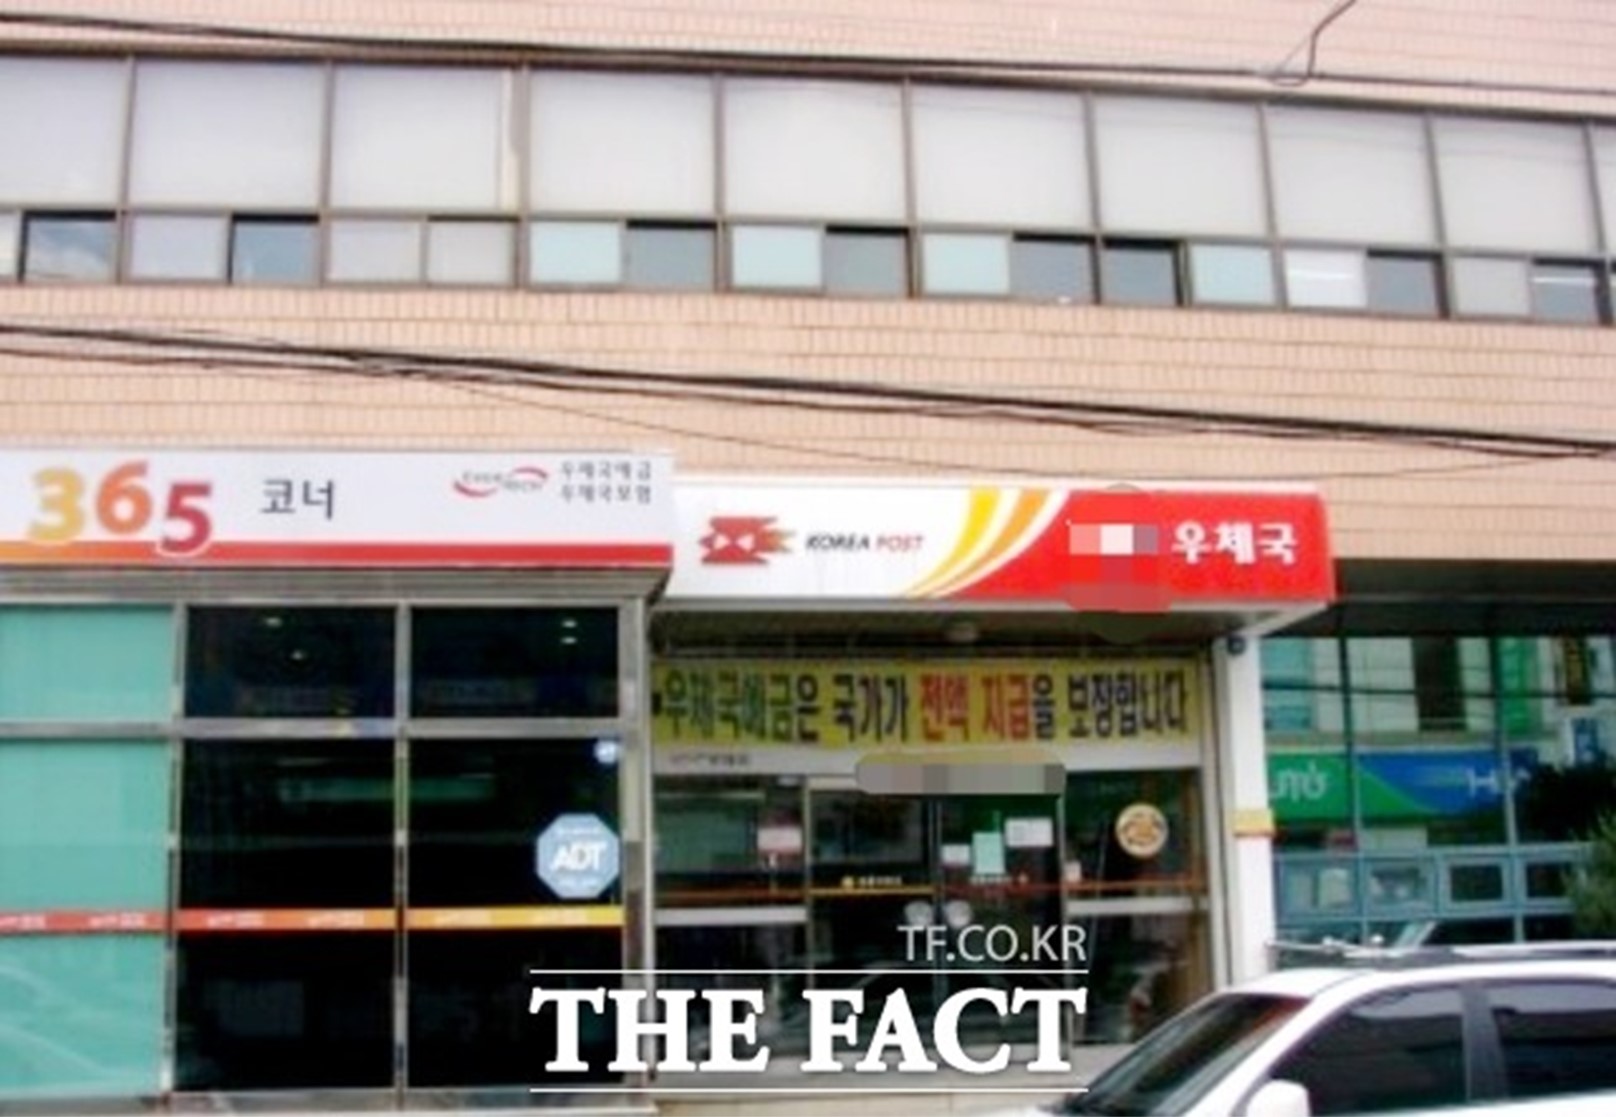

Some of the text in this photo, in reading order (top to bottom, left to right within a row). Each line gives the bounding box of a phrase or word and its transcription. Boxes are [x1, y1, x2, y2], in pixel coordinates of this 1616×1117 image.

[29, 461, 336, 554] 365 코너
[806, 531, 870, 551] KOREA
[1172, 520, 1298, 566] 우체국
[833, 673, 909, 743] 국가가
[981, 673, 1054, 742] 지급을
[1068, 669, 1187, 738] 보장합니다
[549, 840, 609, 872] ADT
